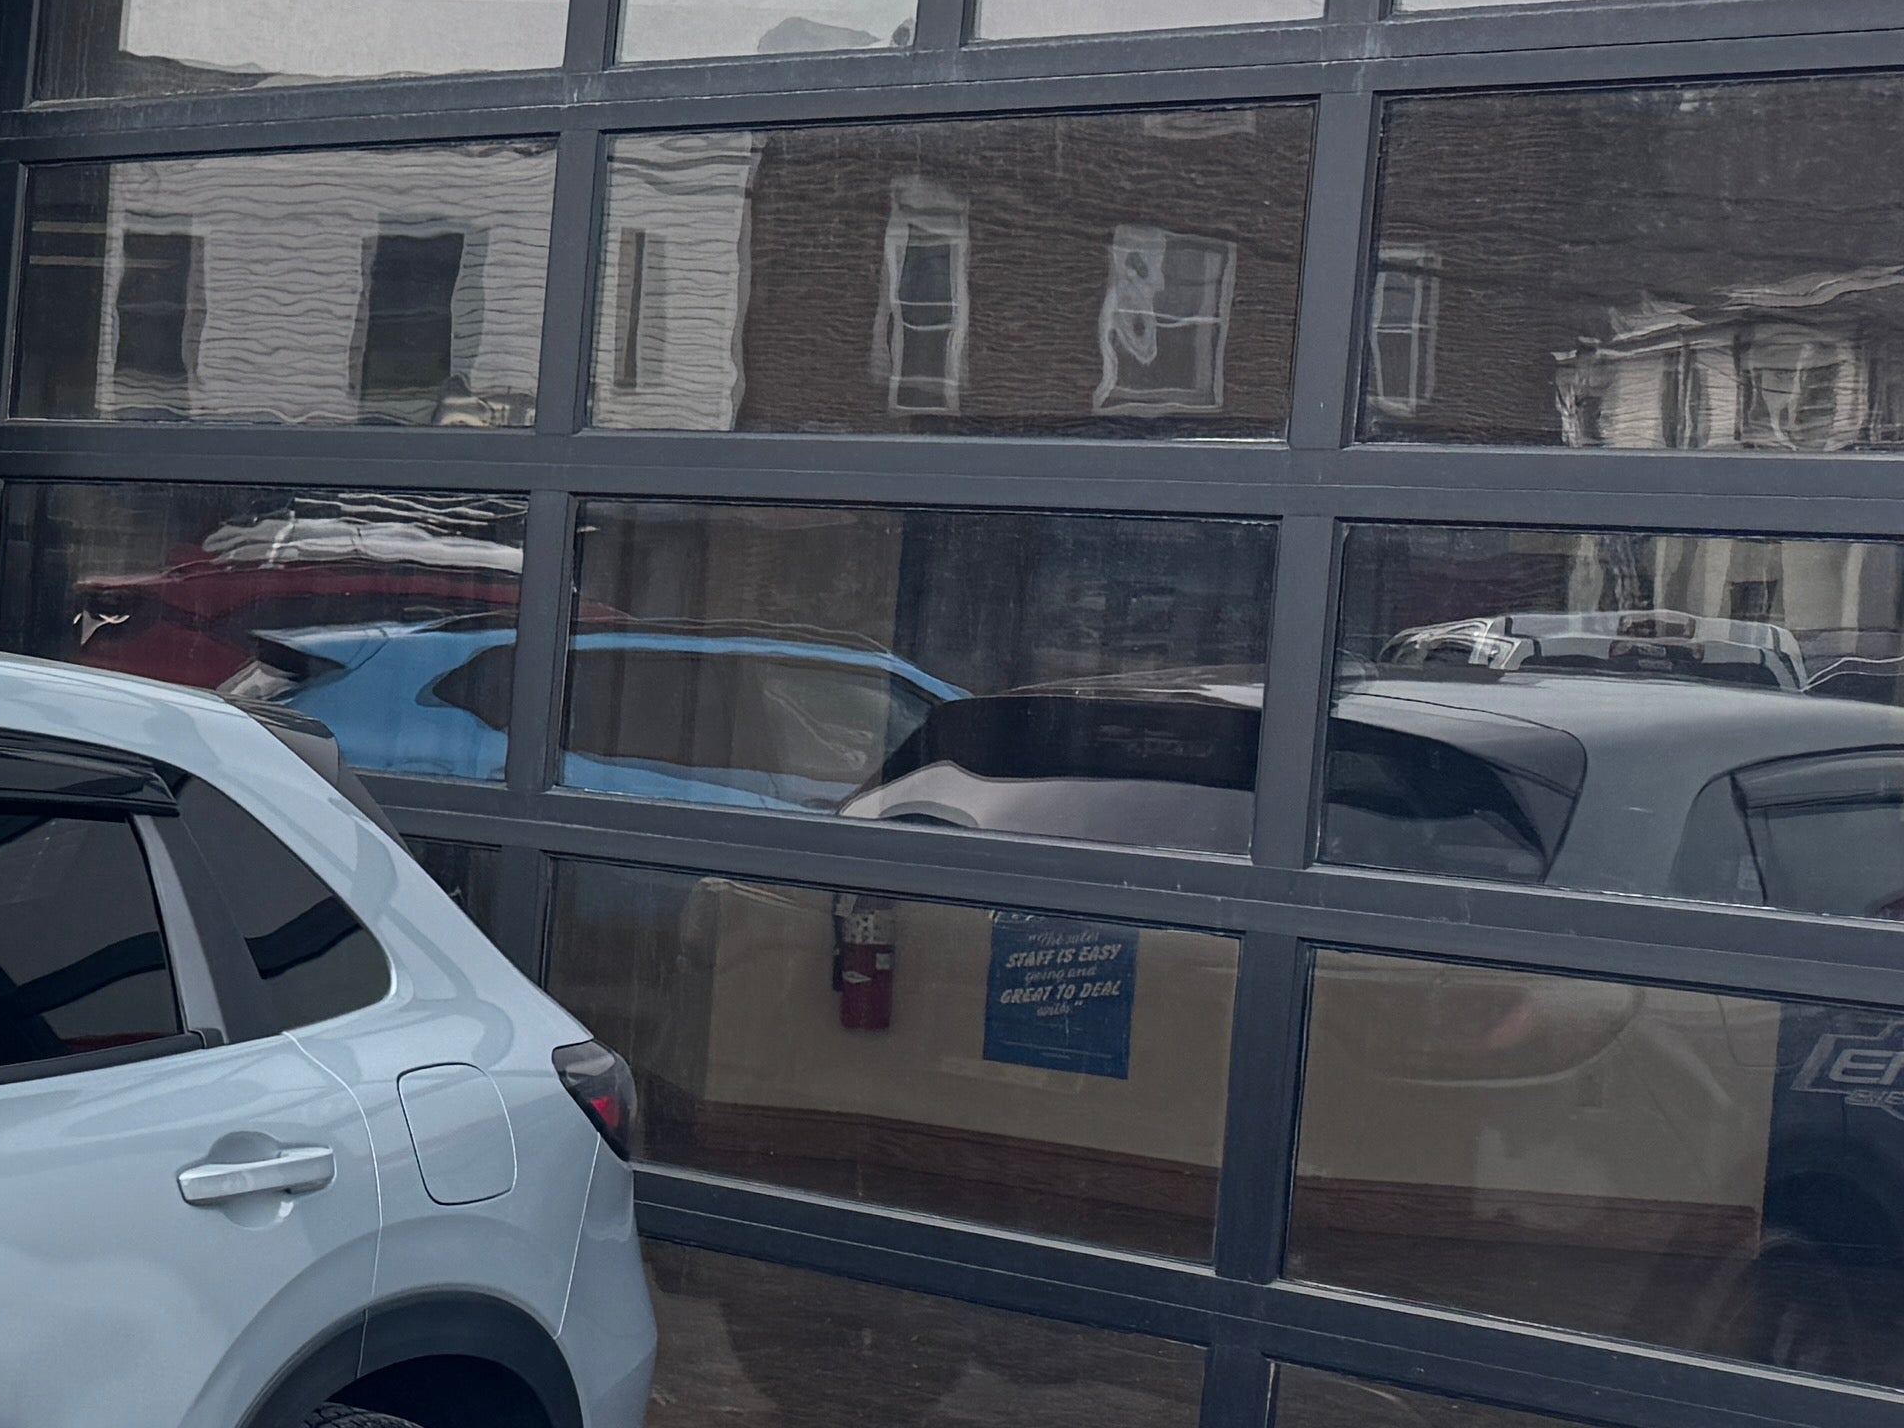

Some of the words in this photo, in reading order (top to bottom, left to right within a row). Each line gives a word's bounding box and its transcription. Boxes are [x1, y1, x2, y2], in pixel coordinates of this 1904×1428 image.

[1005, 950, 1055, 968] STAFF
[1056, 948, 1076, 964] IS
[1078, 944, 1122, 962] EASY
[1000, 985, 1053, 1005] GREAT
[1055, 983, 1077, 1000] TO
[1079, 980, 1122, 999] DEAL
